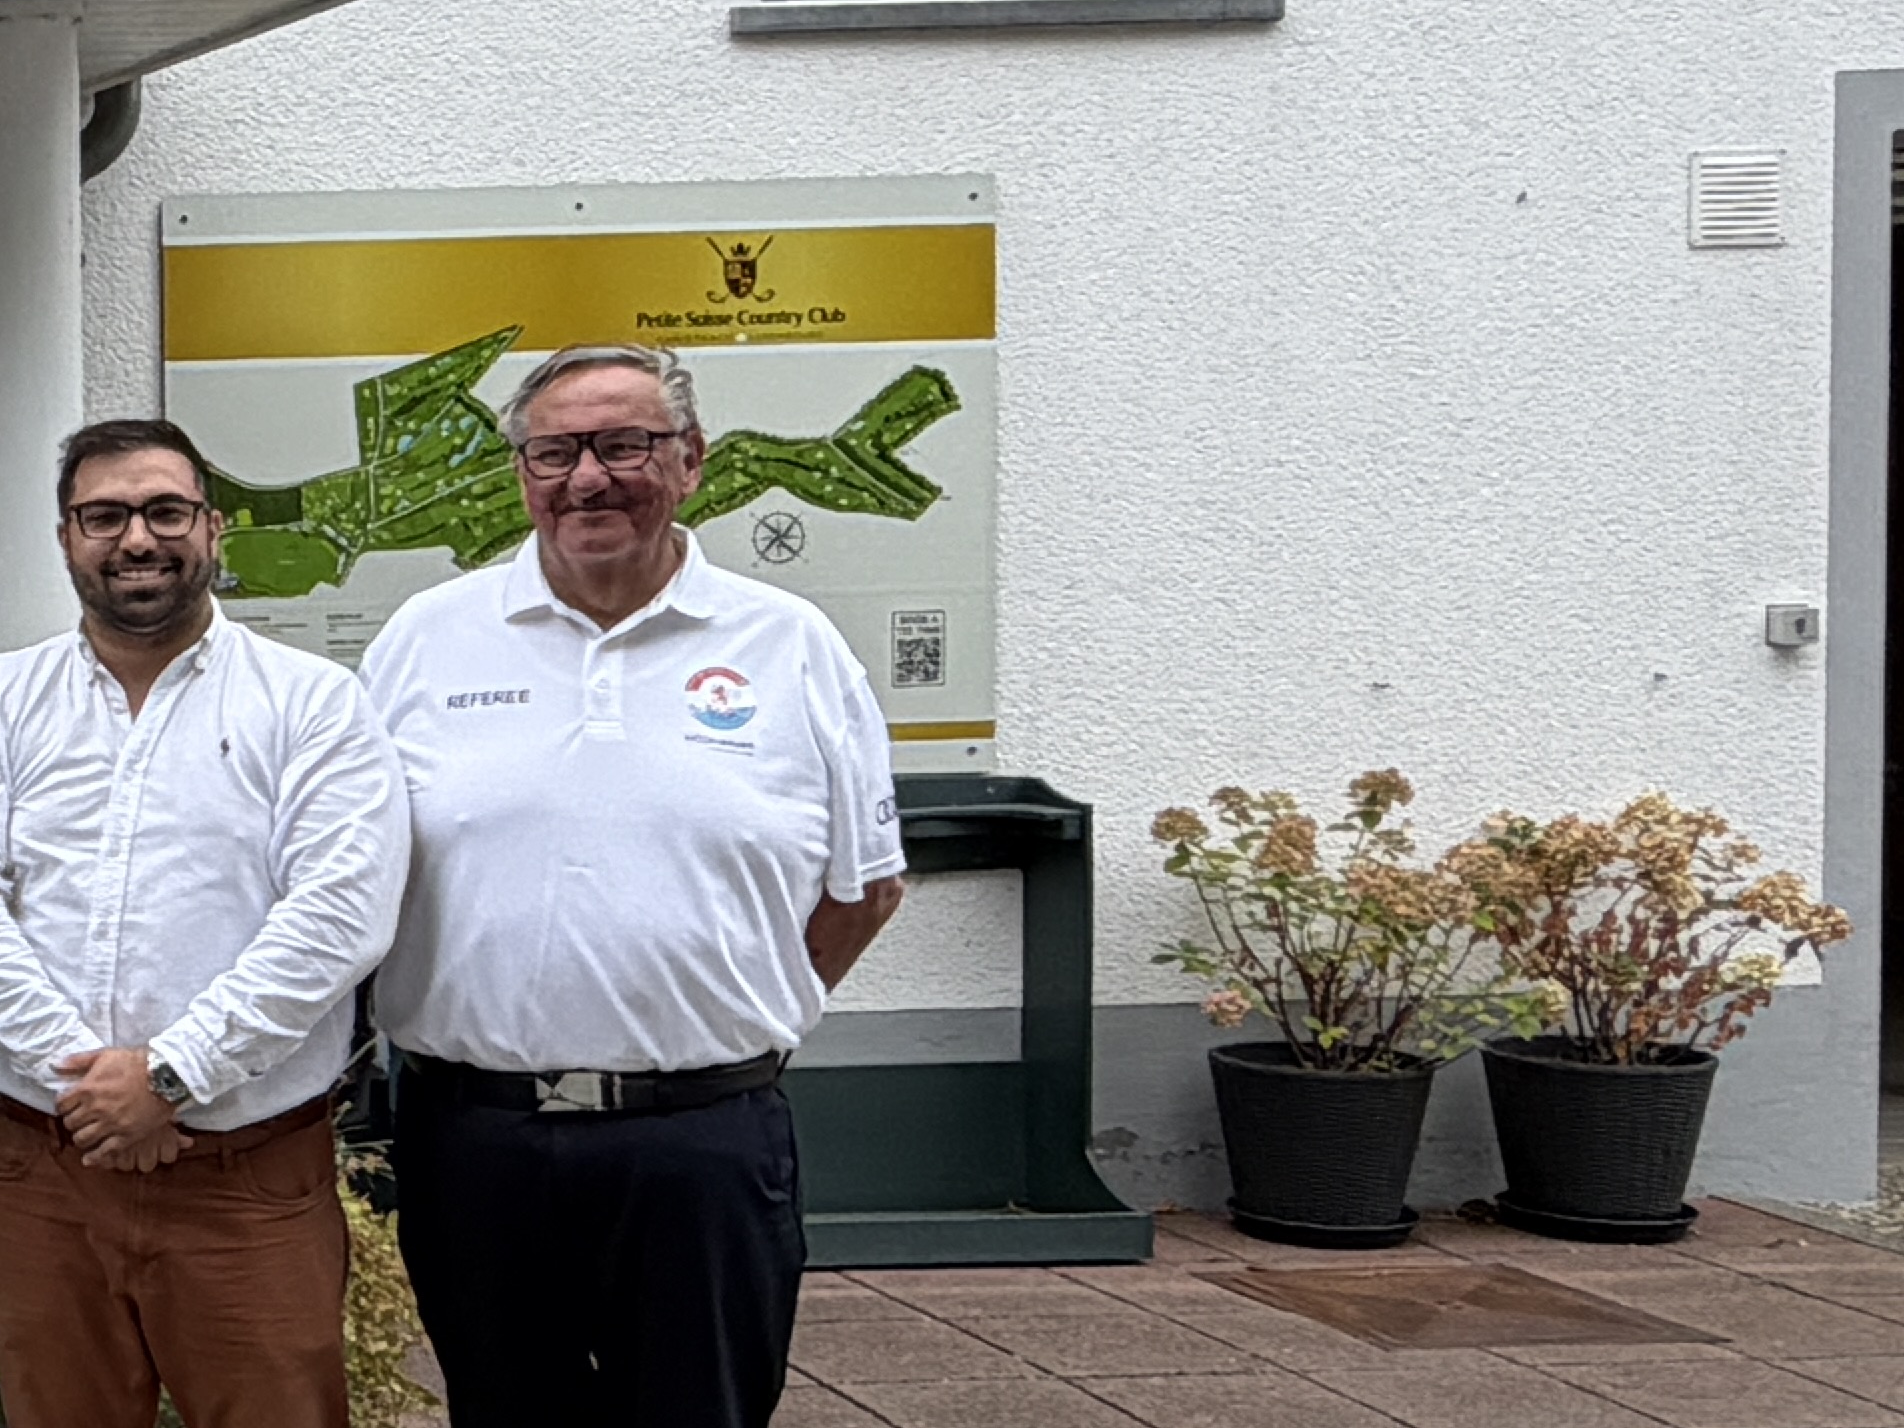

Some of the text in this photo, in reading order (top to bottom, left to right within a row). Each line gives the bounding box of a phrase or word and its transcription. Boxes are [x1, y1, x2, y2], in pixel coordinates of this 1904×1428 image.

[636, 311, 682, 328] Petite
[737, 310, 804, 327] Country
[808, 307, 847, 323] Club
[446, 688, 530, 709] REFEREE
